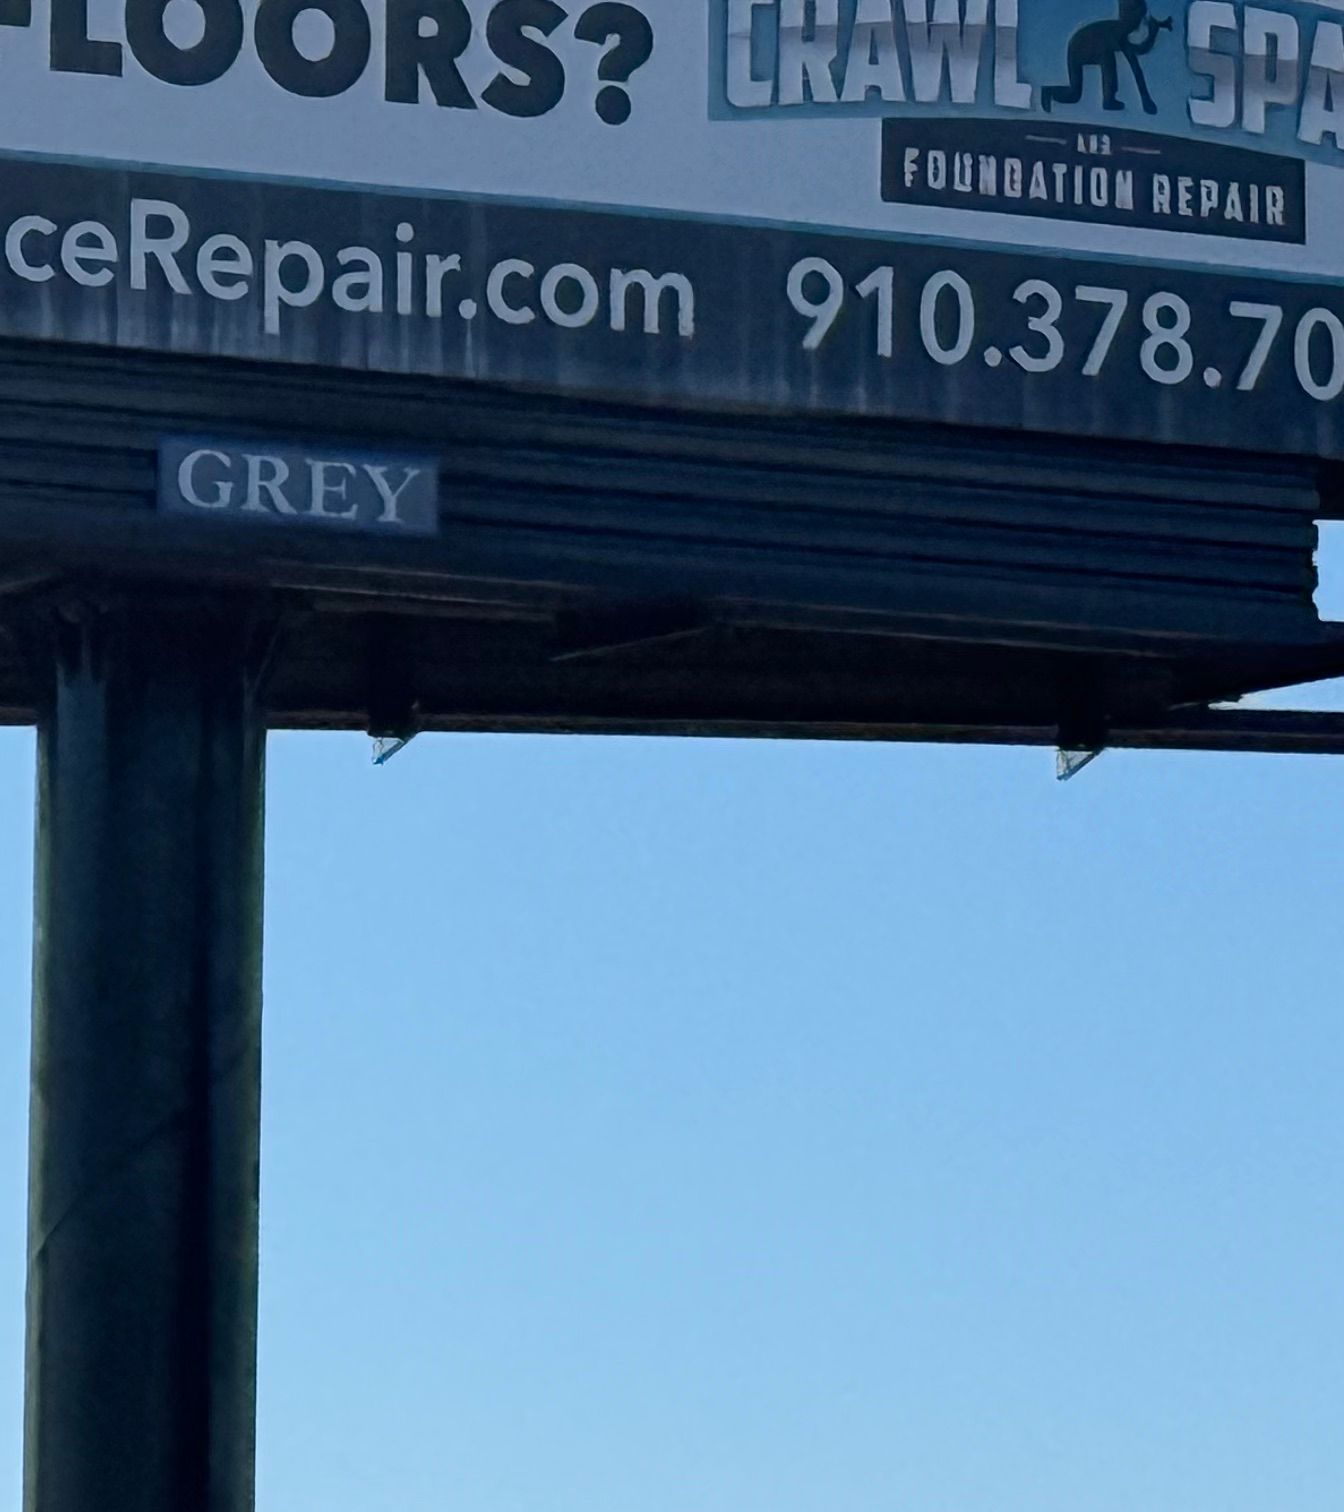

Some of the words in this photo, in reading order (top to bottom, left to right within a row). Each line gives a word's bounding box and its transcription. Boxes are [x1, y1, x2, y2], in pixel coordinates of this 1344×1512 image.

[727, 0, 1032, 108] CRAWL
[904, 146, 1134, 211] FOUNDATION
[1152, 172, 1285, 226] REPAIR
[787, 256, 1344, 401] 910.378.70
[177, 449, 421, 524] GREY
